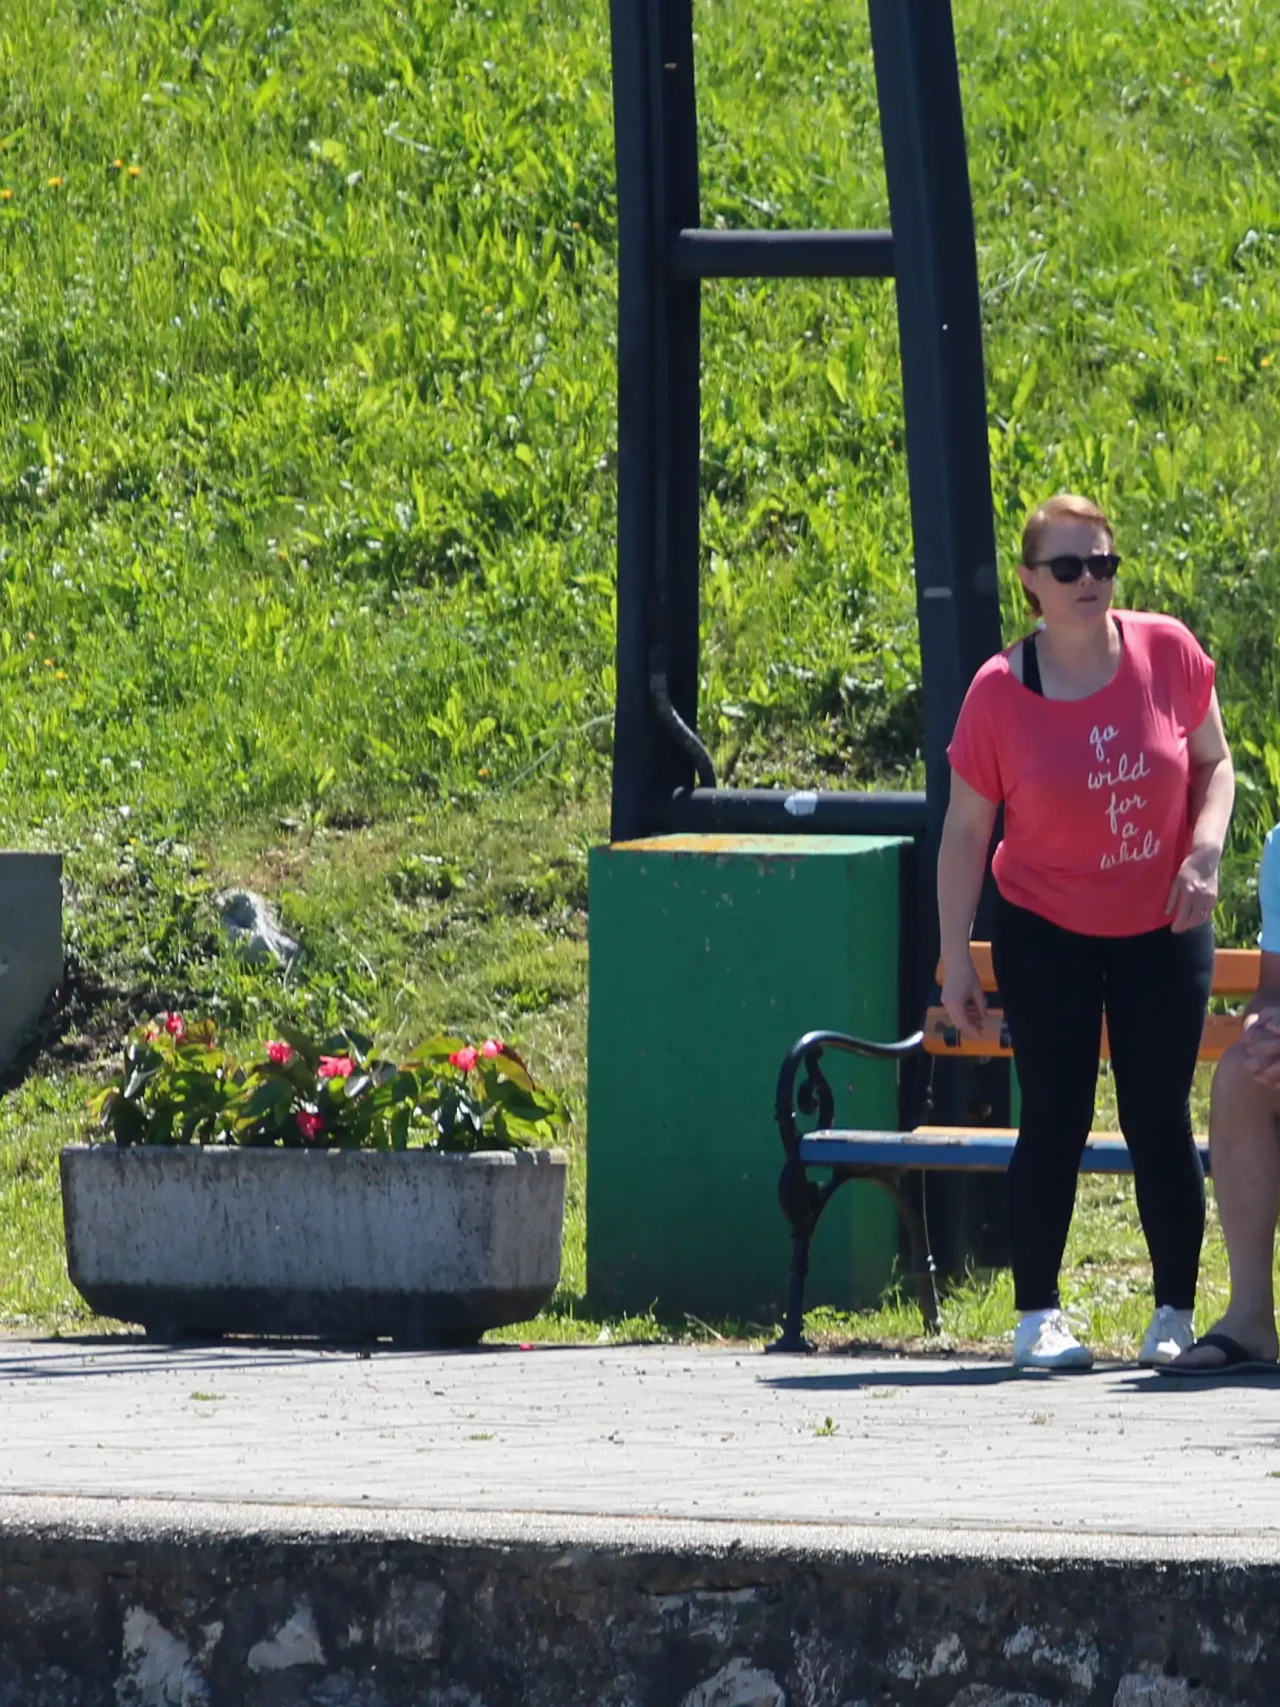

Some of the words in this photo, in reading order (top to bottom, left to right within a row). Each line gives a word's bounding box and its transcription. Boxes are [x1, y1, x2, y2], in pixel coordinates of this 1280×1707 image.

[1089, 724, 1119, 762] go
[1087, 751, 1151, 790] wild
[1105, 791, 1147, 836] for
[1122, 821, 1139, 839] a
